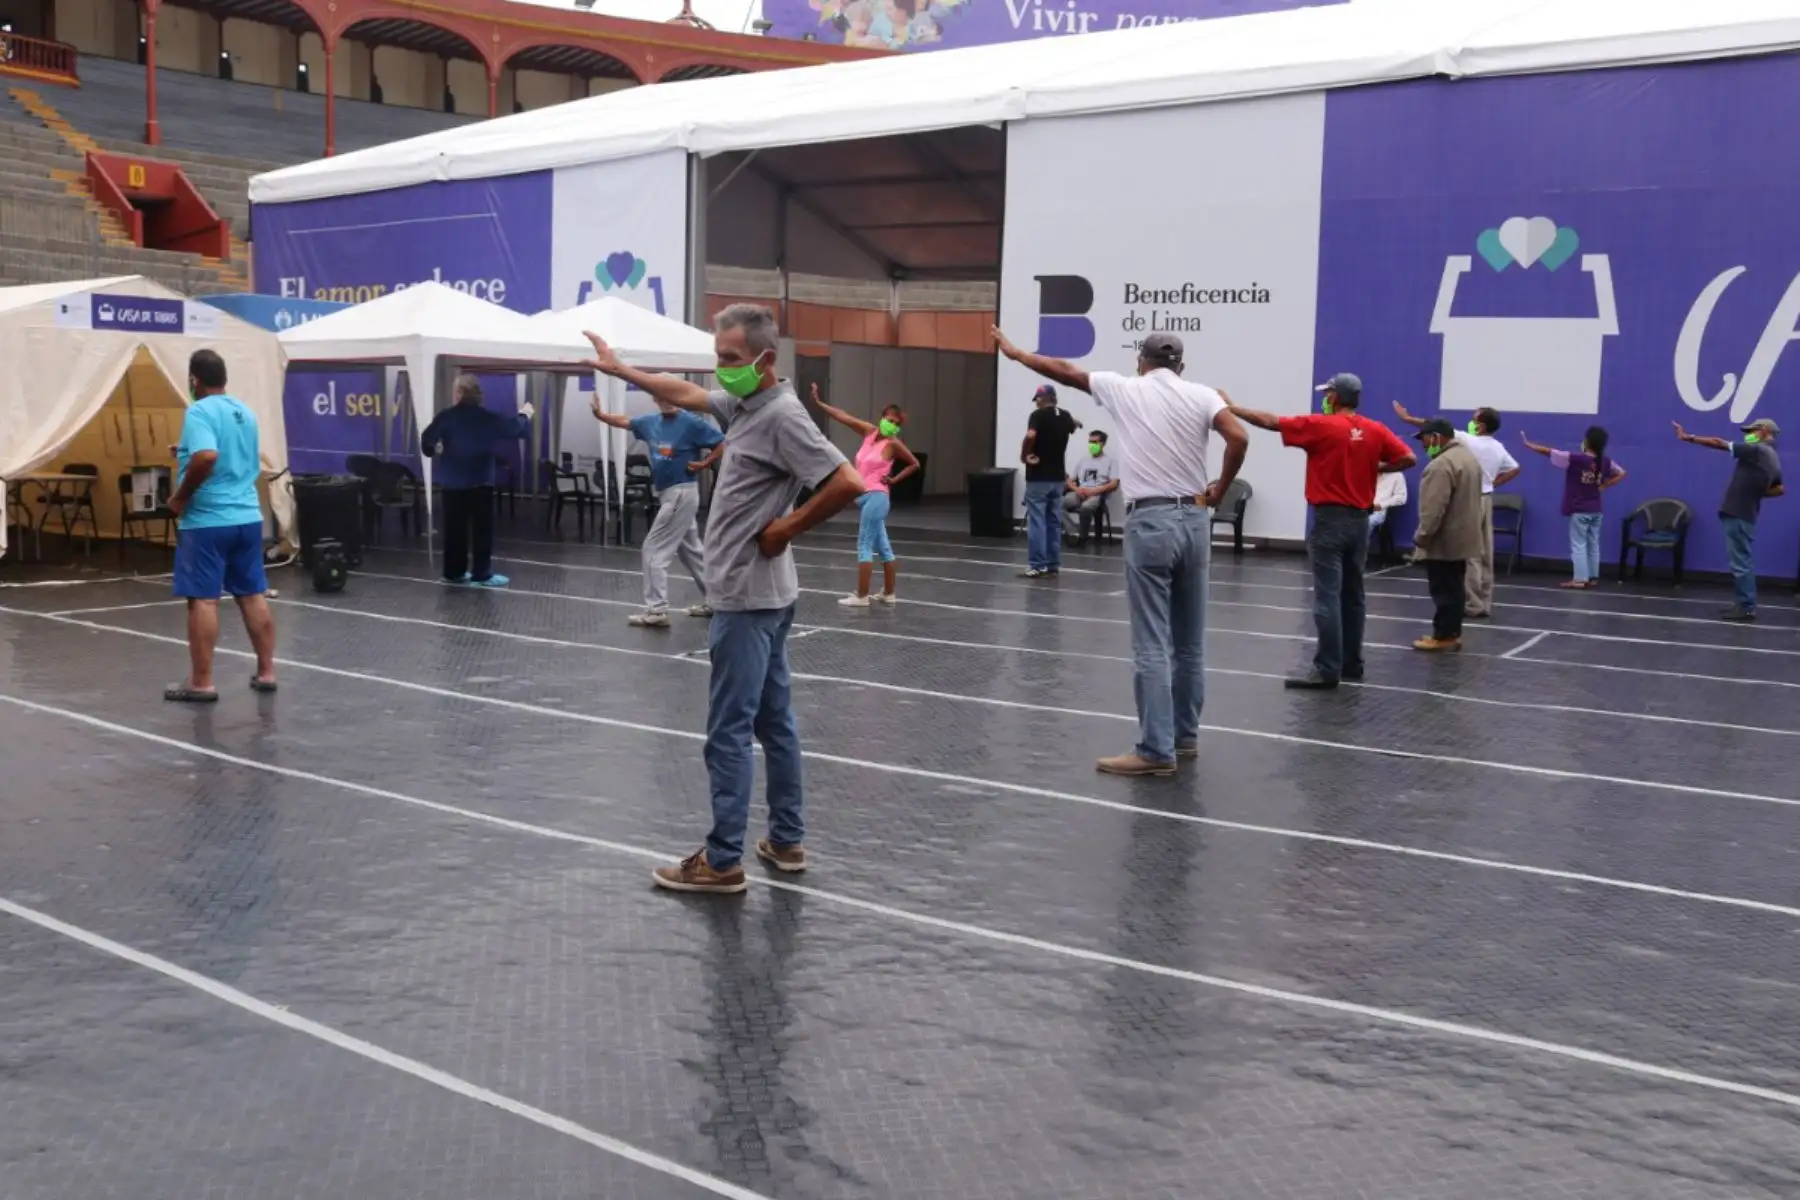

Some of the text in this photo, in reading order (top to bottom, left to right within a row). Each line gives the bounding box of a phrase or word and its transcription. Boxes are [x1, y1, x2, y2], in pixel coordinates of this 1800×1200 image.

[1004, 0, 1099, 34] Vivir
[279, 276, 306, 299] El
[315, 284, 386, 304] amor
[1123, 281, 1271, 304] Beneficencia
[1121, 310, 1201, 332] de Lima
[313, 380, 336, 416] el
